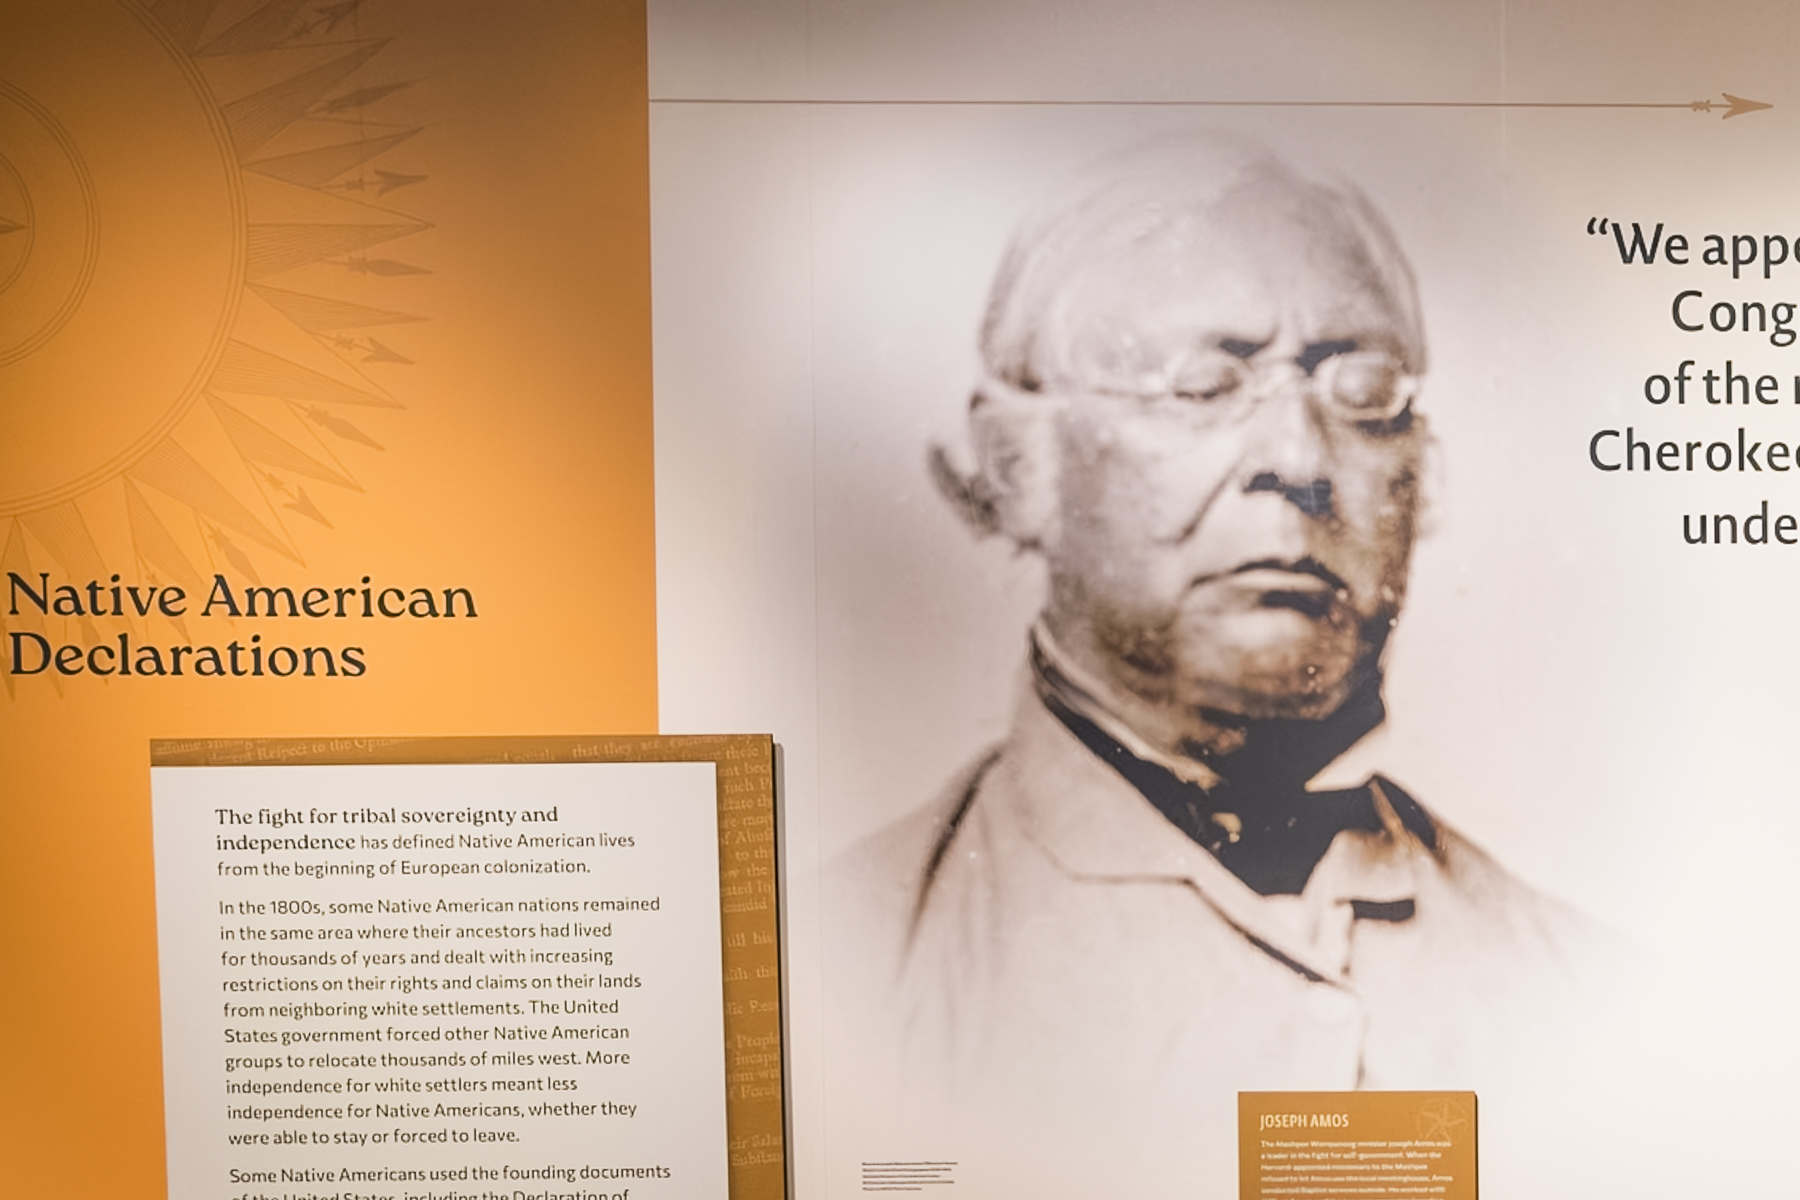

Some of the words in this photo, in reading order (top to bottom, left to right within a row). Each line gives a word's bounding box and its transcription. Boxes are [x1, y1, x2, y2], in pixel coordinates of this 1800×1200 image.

[1643, 359, 1696, 405] of
[1701, 359, 1779, 405] the
[7, 573, 186, 615] Native
[200, 575, 477, 616] American
[9, 633, 366, 677] Declarations
[214, 809, 252, 824] The
[258, 809, 304, 827] fight
[310, 808, 337, 823] for
[342, 808, 395, 822] tribal
[401, 807, 516, 826] sovereignty
[521, 806, 558, 821] and
[216, 834, 355, 854] independence
[360, 835, 388, 848] has
[392, 834, 454, 848] defined
[459, 834, 512, 847] Native
[517, 833, 595, 847] American
[599, 833, 635, 846] lives
[217, 862, 258, 875] from
[262, 862, 289, 875] the
[294, 861, 375, 878] beginning
[379, 860, 396, 874] of
[401, 861, 479, 876] European
[484, 859, 590, 873] colonization.
[219, 901, 234, 914] In
[238, 901, 265, 914] the
[269, 901, 325, 915] 1800s,
[328, 902, 373, 913] some
[378, 899, 431, 912] Native
[435, 898, 513, 912] American
[518, 898, 578, 911] nations
[583, 897, 659, 911] remained
[220, 927, 234, 939] in
[239, 926, 266, 939] the
[270, 929, 313, 940] same
[317, 928, 353, 939] area
[357, 925, 408, 938] where
[413, 924, 451, 938] their
[456, 925, 536, 937] ancestors
[540, 923, 569, 937] had
[574, 923, 611, 936] lived
[1260, 1114, 1306, 1129] JOSEPH
[1310, 1114, 1348, 1126] AMOS
